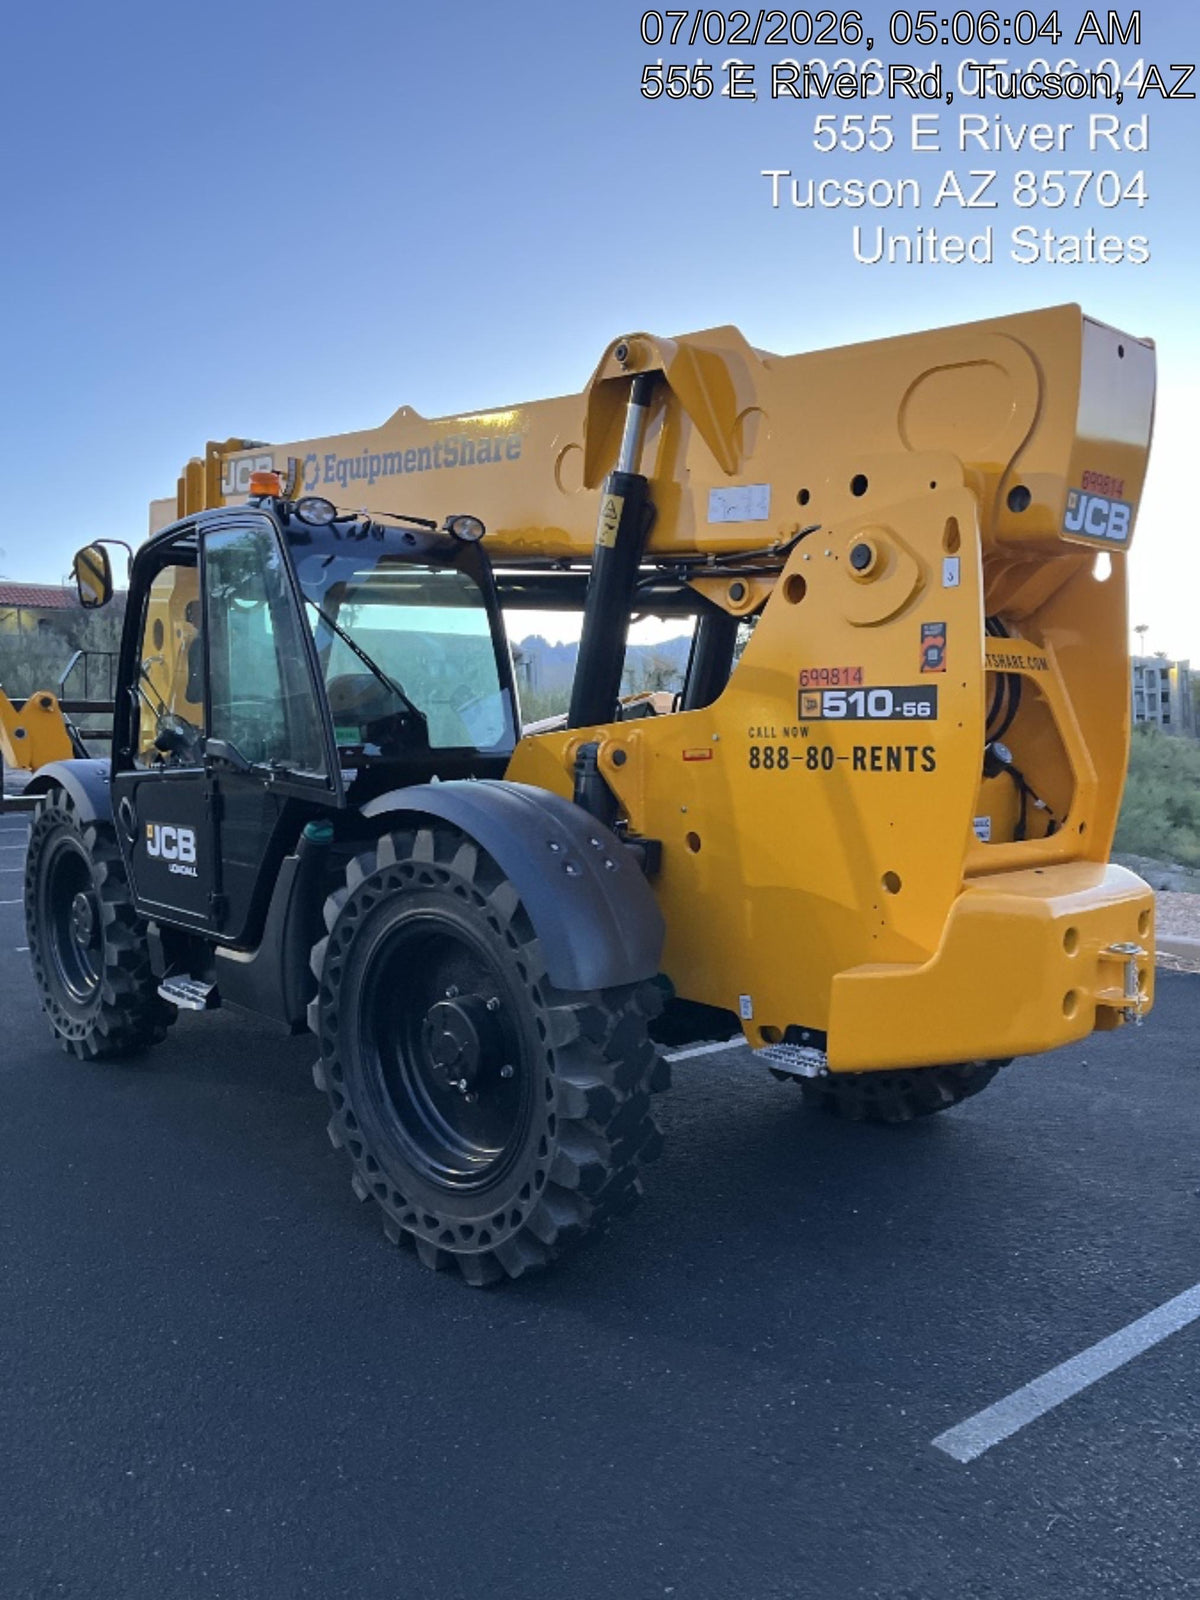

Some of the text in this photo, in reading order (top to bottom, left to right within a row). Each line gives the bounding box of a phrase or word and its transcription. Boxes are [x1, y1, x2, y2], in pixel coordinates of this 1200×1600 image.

[322, 433, 522, 488] EquipmentShare
[1065, 495, 1130, 540] JCB
[800, 667, 863, 687] 699814
[748, 726, 809, 738] CALL NOW
[749, 745, 937, 773] 888-80-RENTS
[147, 824, 197, 863] JCB
